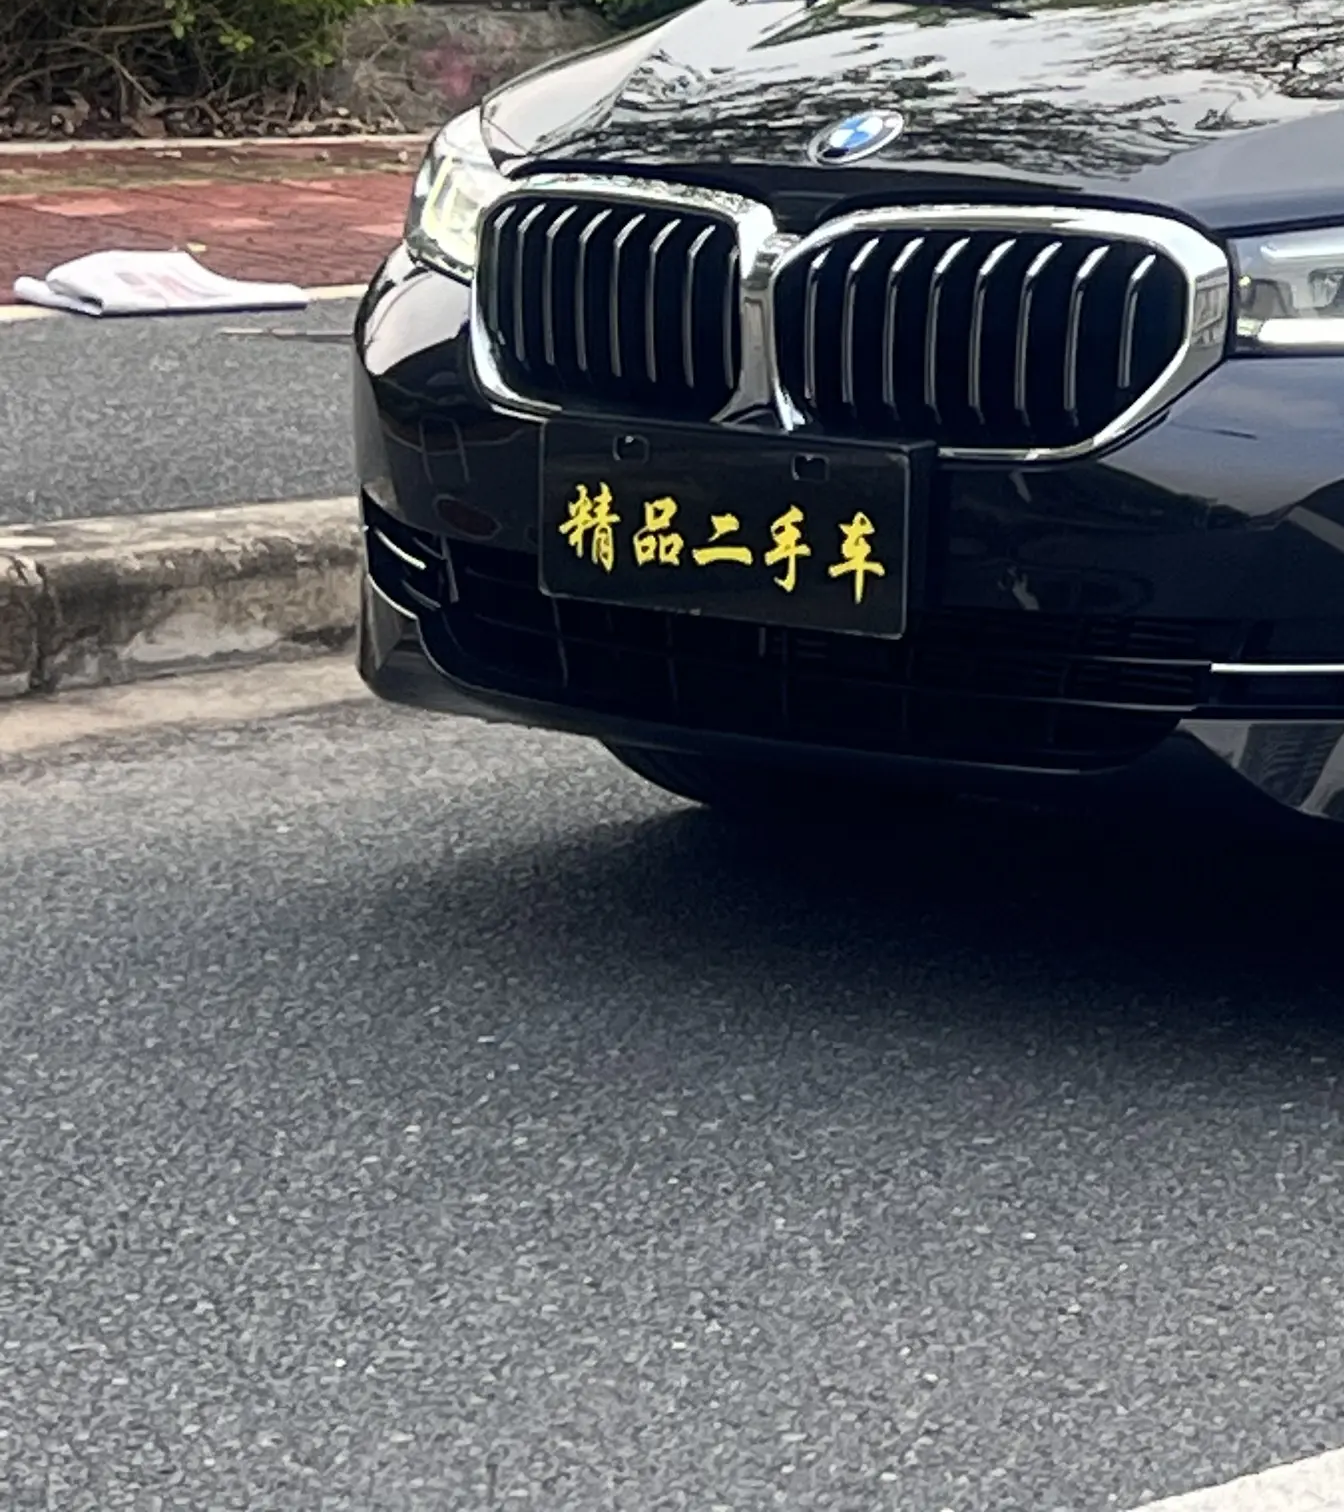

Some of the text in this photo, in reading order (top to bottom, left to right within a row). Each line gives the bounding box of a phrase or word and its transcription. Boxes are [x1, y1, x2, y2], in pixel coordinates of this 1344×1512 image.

[558, 482, 886, 605] 精品二手车
